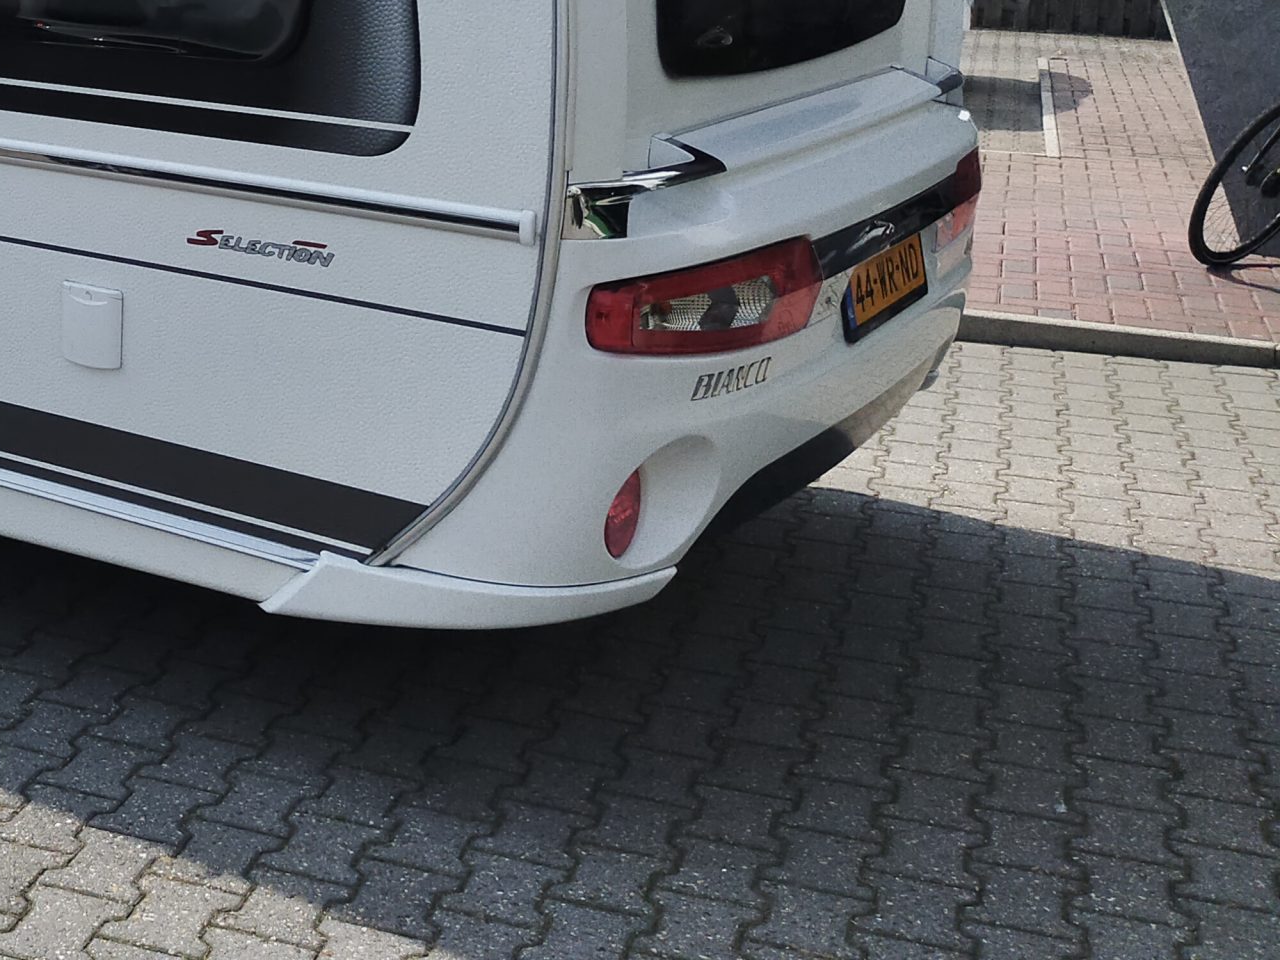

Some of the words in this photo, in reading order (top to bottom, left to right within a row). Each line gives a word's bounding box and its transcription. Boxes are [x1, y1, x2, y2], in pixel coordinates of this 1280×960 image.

[186, 229, 335, 267] SELECTION
[855, 243, 920, 313] 44-WR-ND
[690, 356, 773, 402] BIANCO
